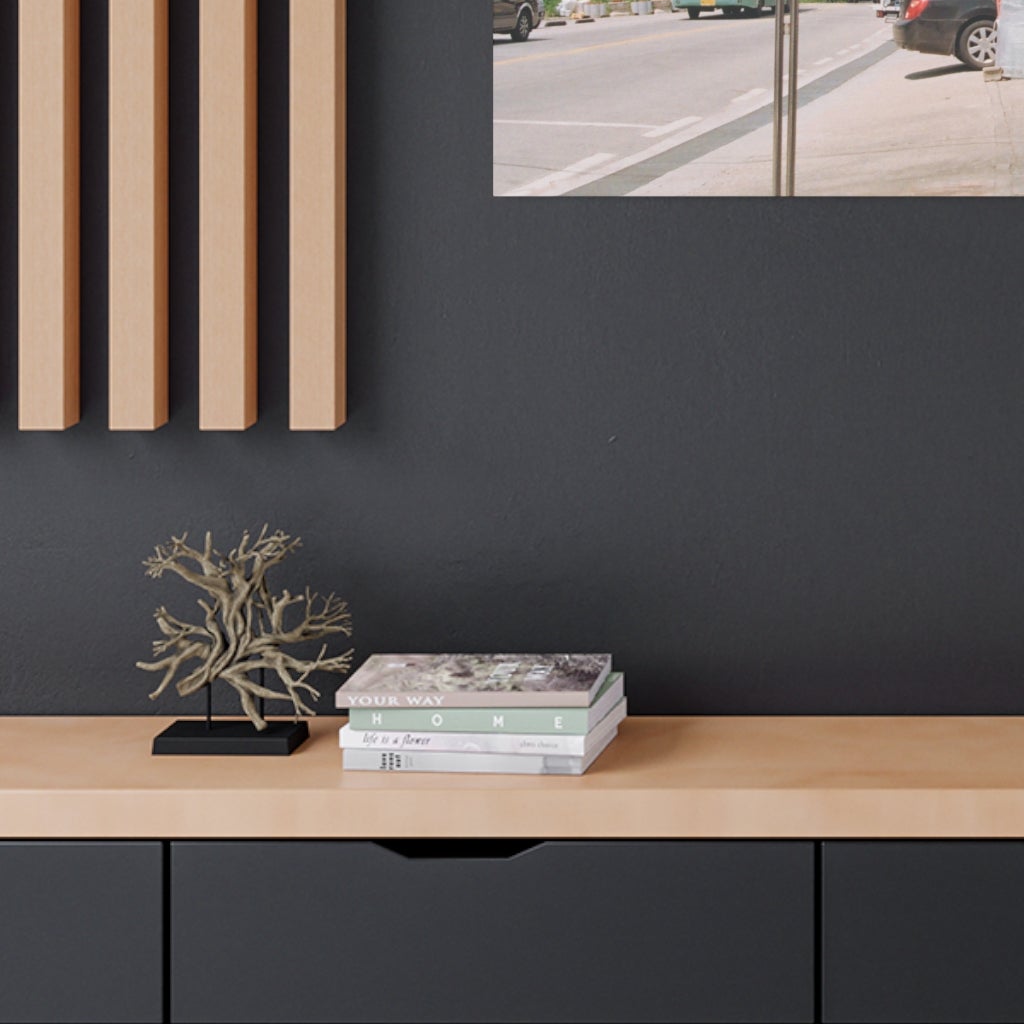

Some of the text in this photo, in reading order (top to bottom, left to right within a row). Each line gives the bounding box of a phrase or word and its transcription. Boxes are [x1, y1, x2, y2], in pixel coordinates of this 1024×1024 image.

[348, 695, 445, 706] YOUR WAY
[362, 732, 378, 747] life
[381, 735, 390, 744] is
[400, 733, 432, 748] flower
